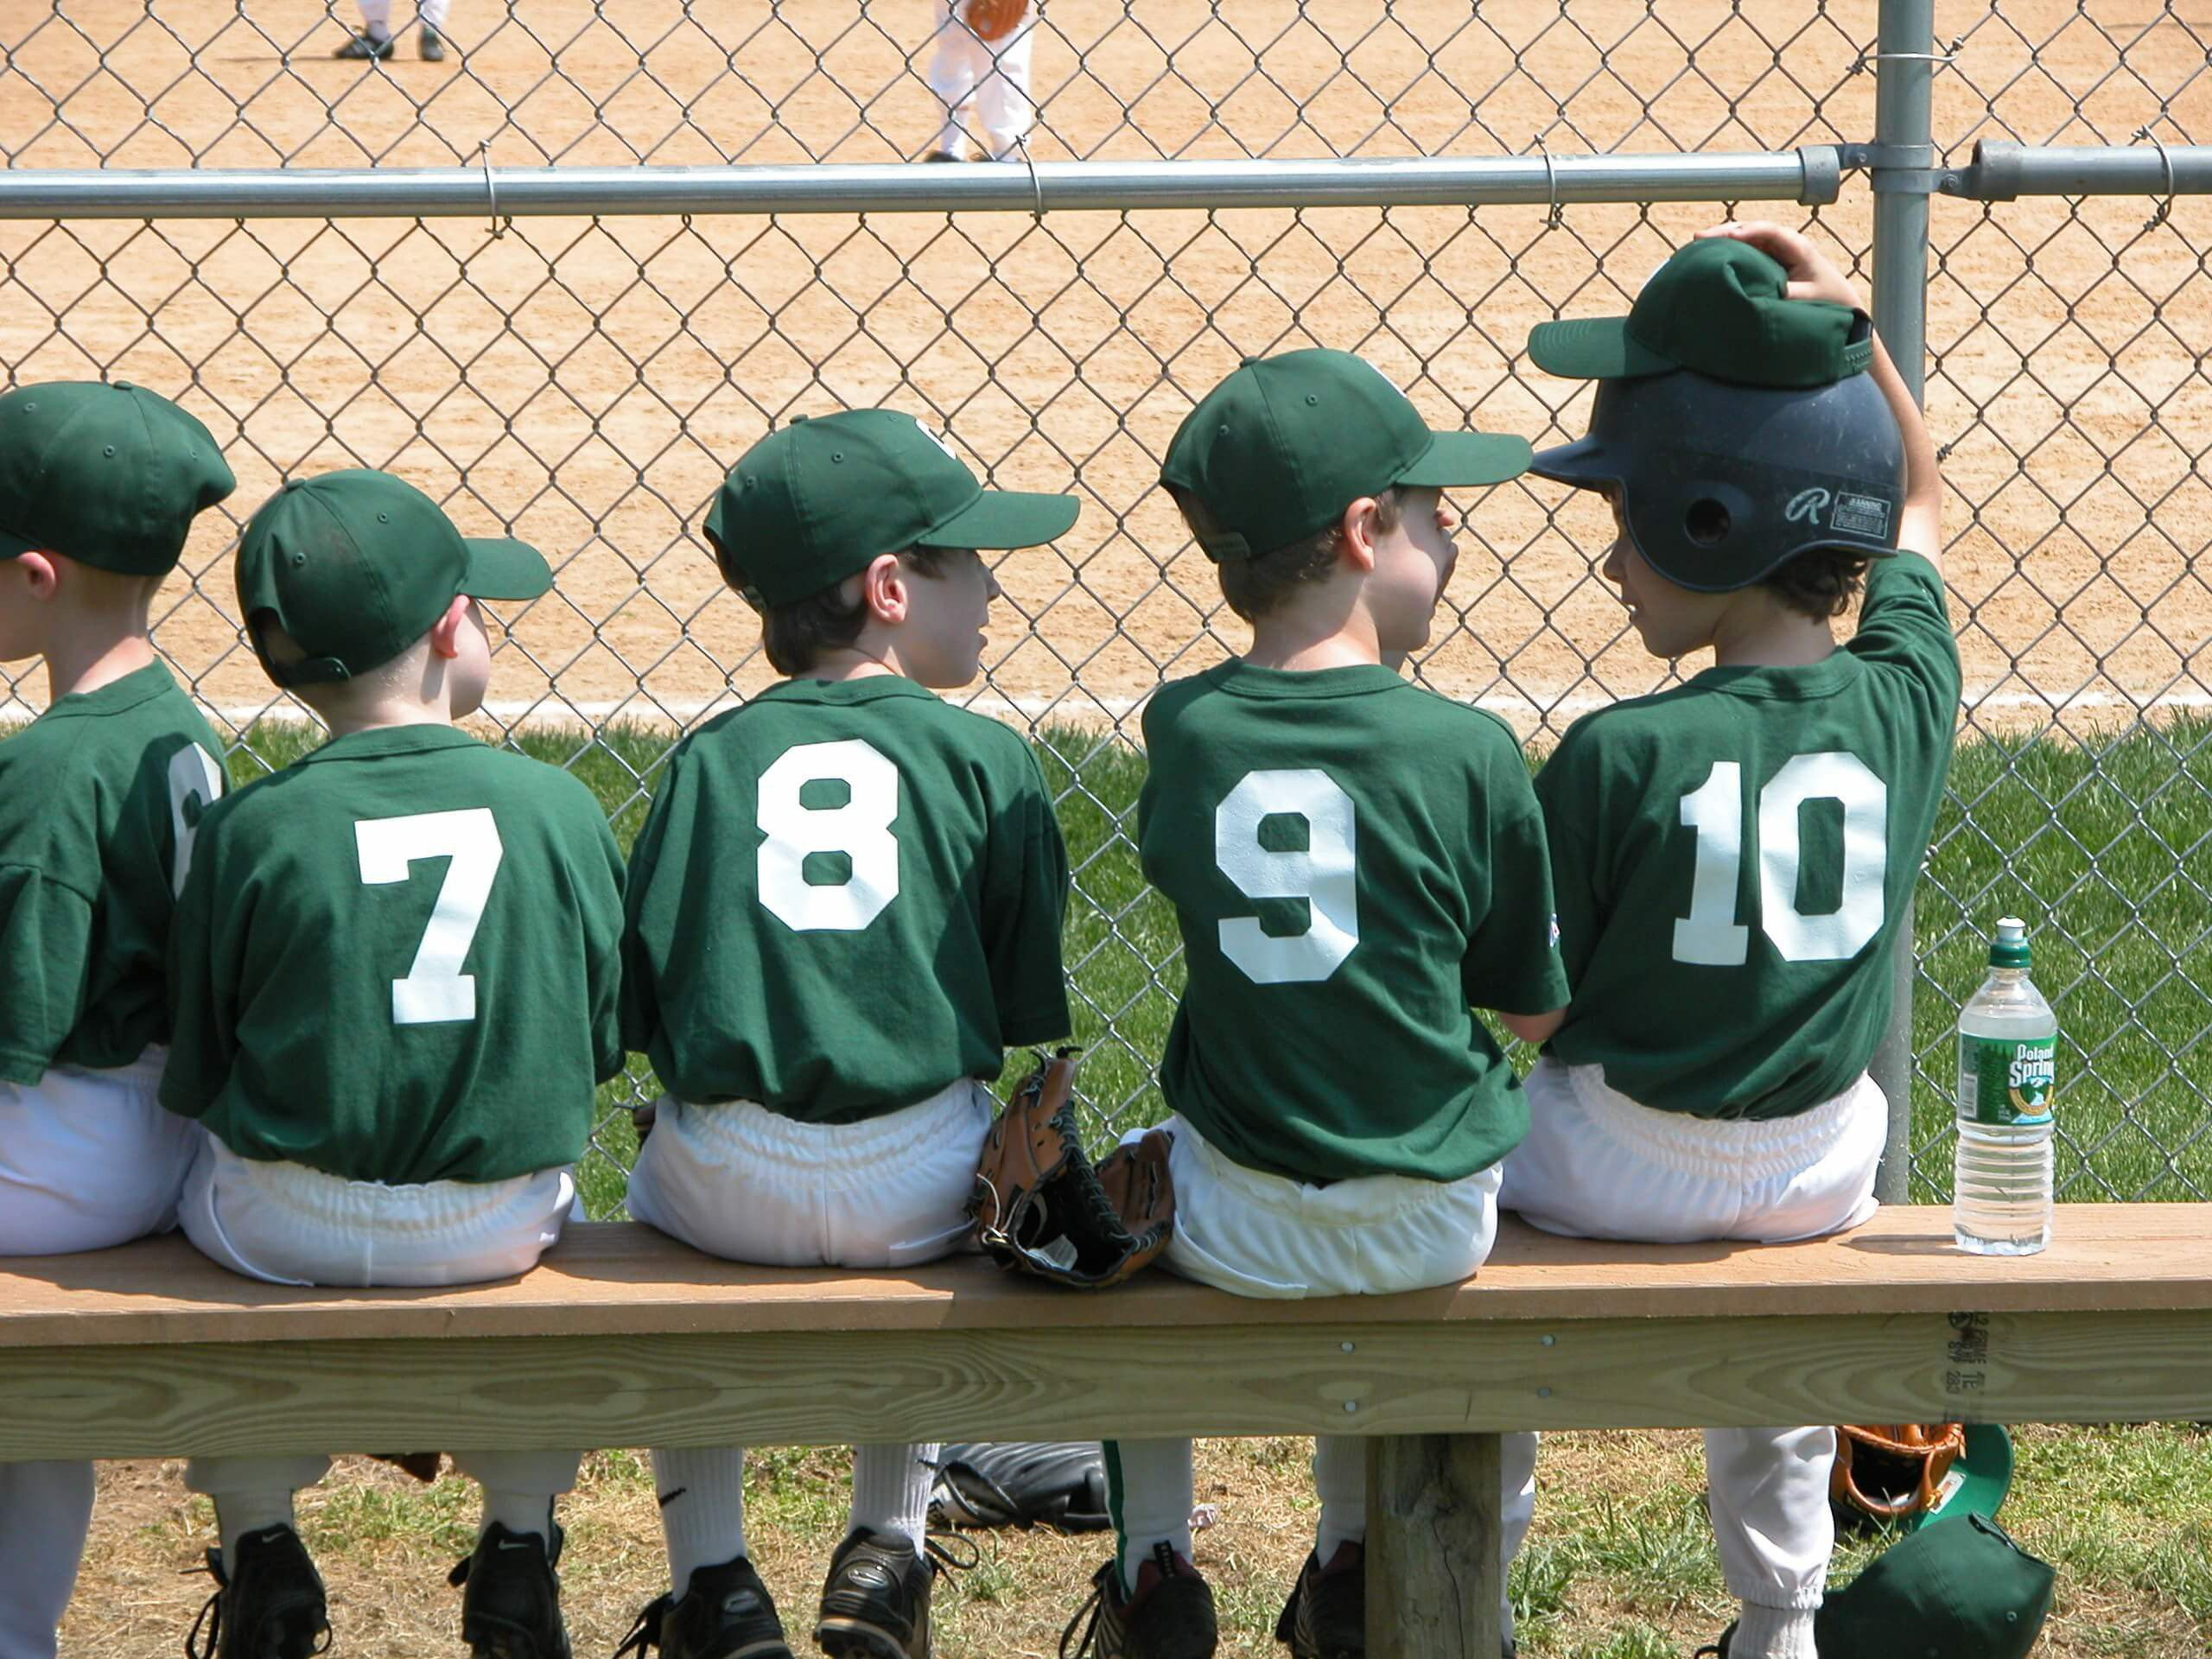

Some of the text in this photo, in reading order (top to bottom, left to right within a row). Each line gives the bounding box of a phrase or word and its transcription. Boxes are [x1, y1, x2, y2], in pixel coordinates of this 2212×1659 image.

[353, 807, 504, 1024] 7
[756, 739, 899, 932] 8
[1215, 768, 1359, 983] 9
[1673, 751, 1887, 965] 10
